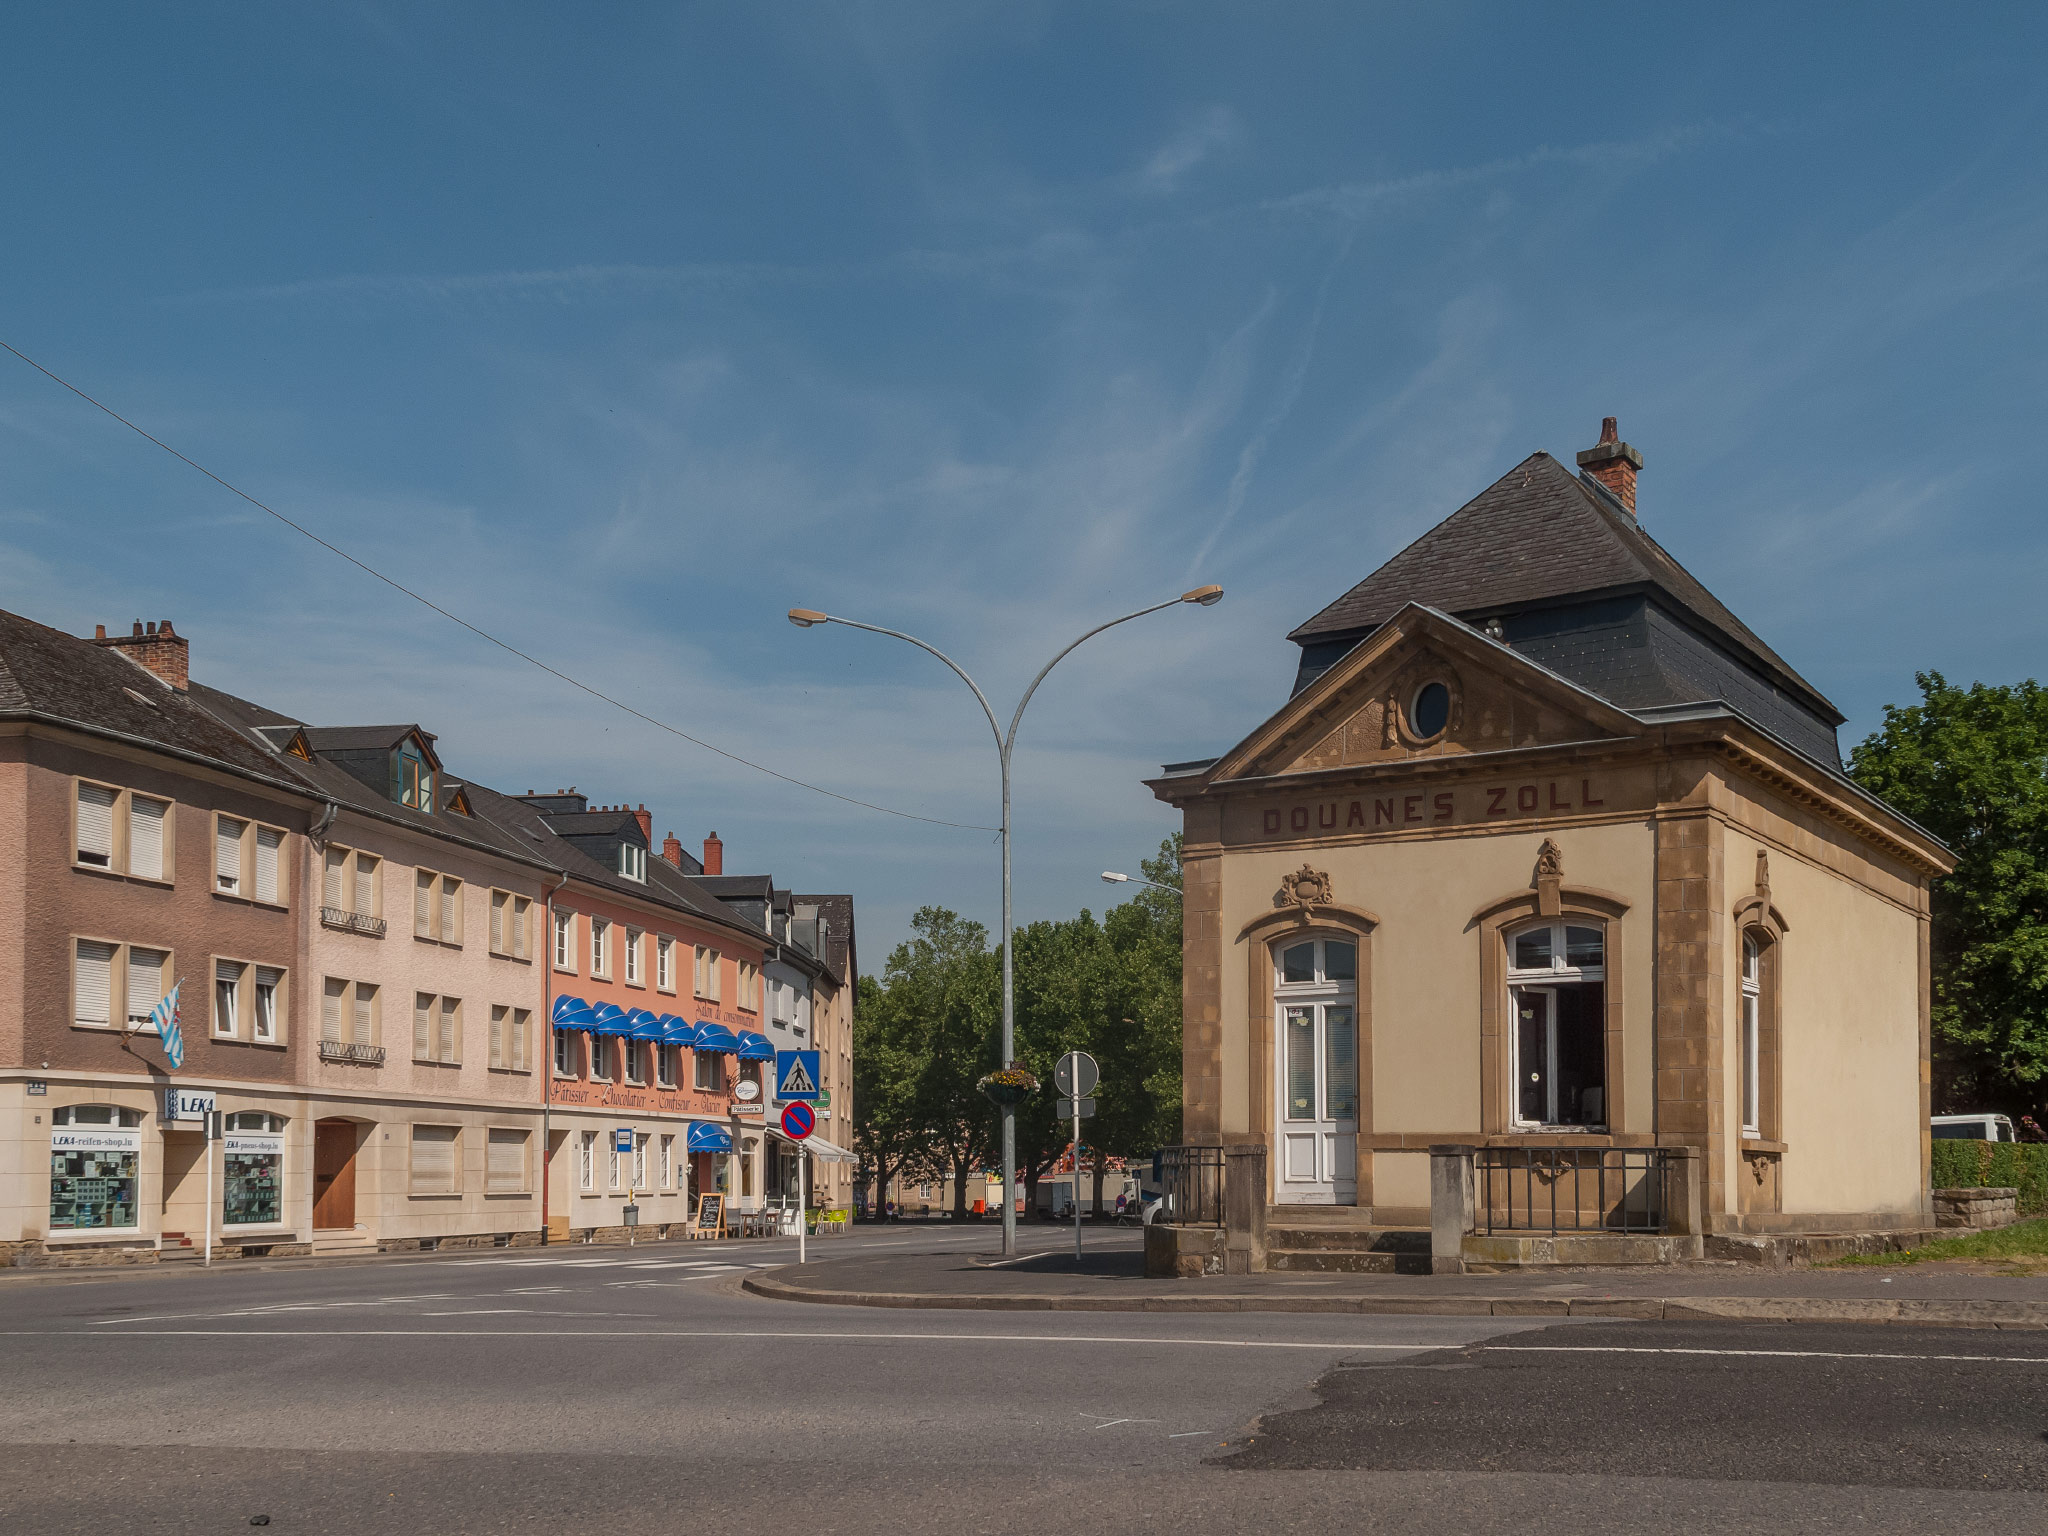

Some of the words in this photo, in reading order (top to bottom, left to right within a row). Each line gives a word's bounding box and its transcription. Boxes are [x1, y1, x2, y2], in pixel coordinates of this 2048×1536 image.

[1263, 792, 1455, 835] DOUANES
[1486, 779, 1604, 816] ZOLL
[181, 1097, 214, 1112] LEKA
[53, 1136, 133, 1148] LEKA-reifen-shop.lu
